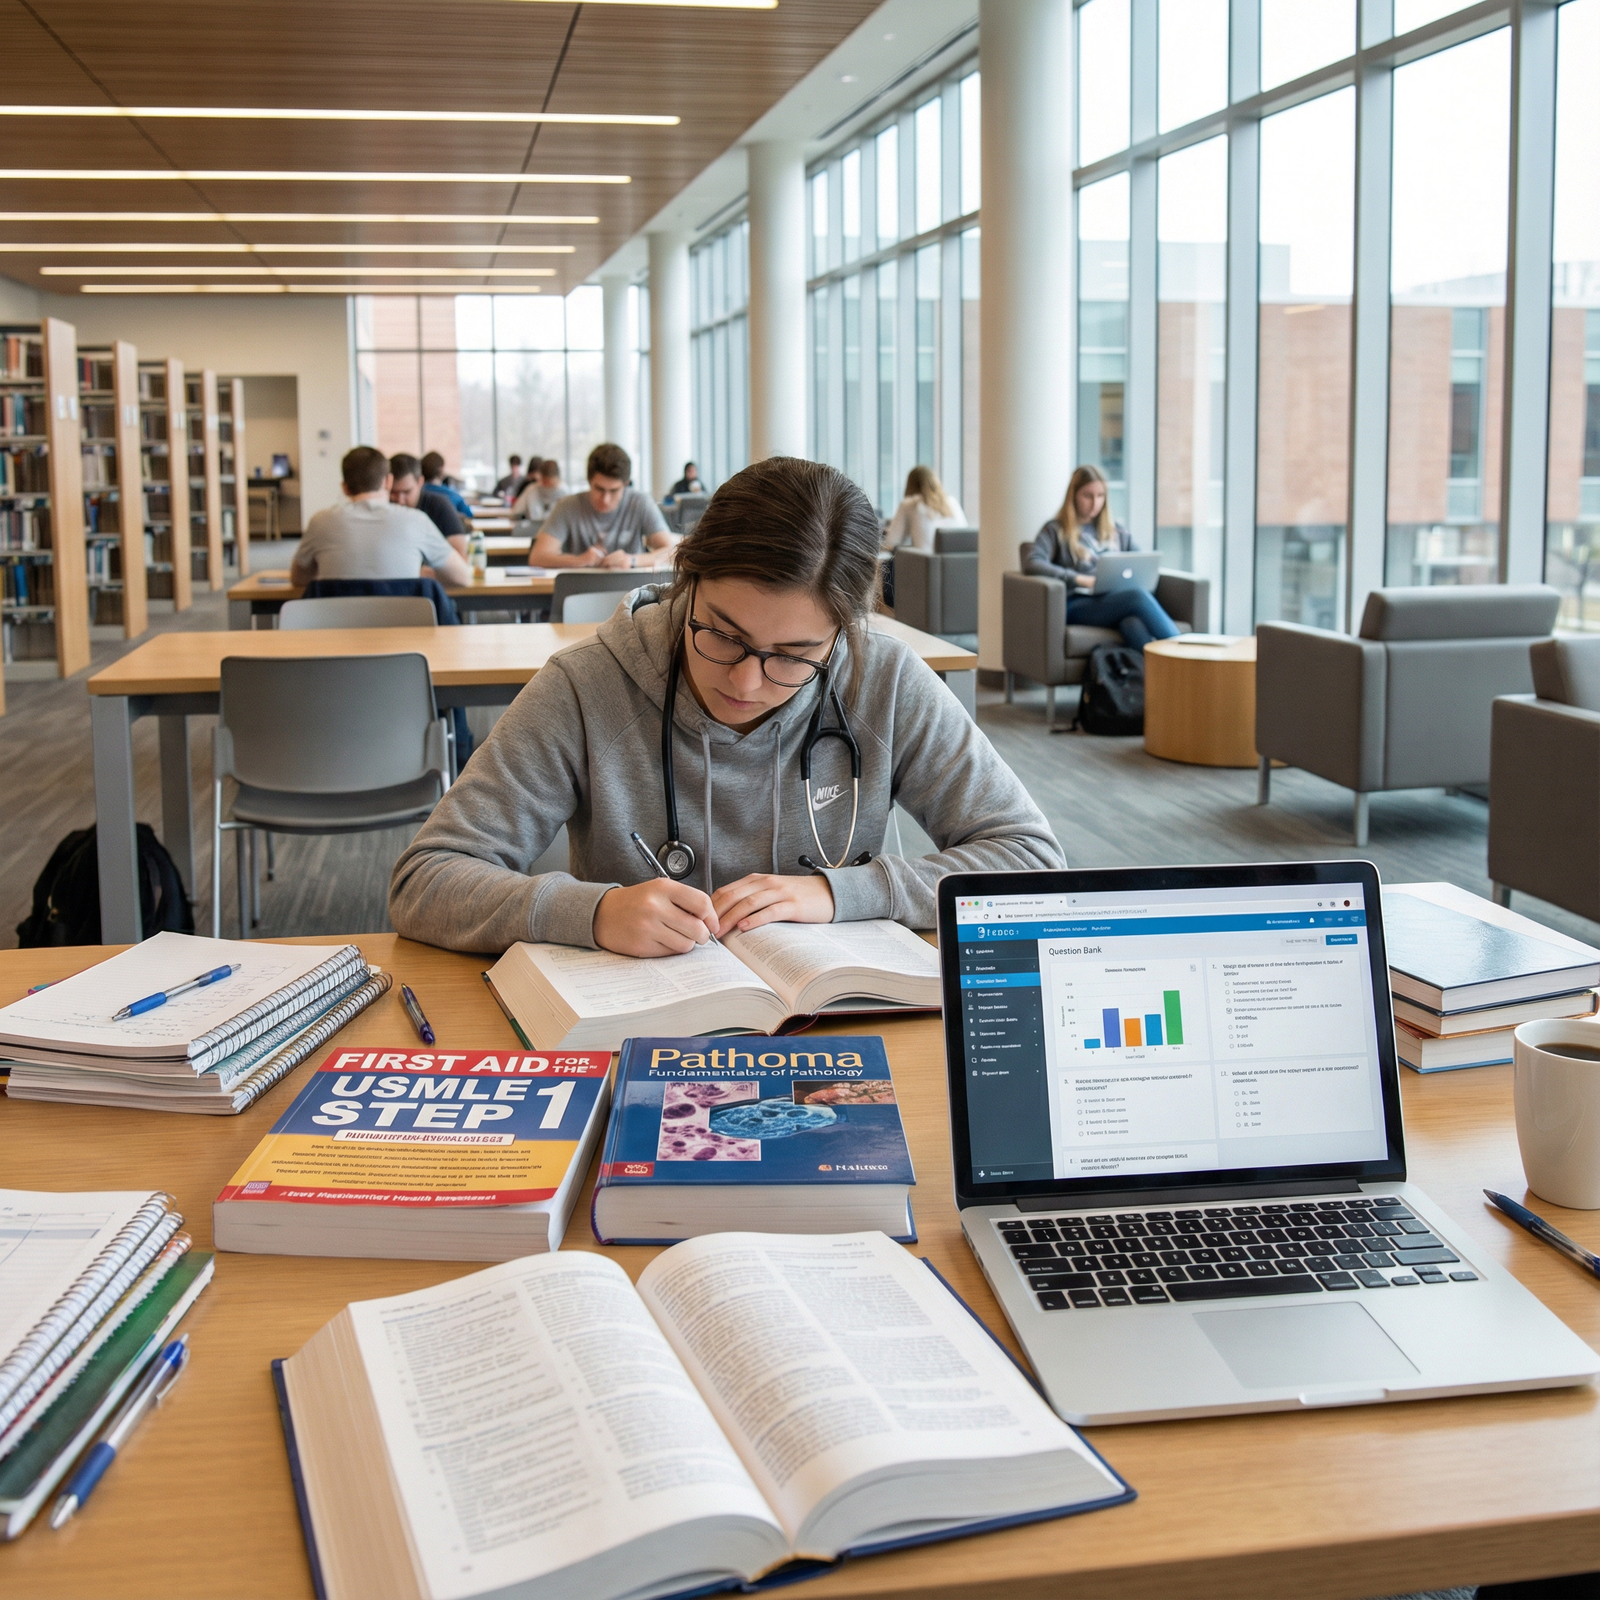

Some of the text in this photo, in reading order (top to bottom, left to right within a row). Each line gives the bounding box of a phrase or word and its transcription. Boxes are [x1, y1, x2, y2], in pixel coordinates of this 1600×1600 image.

[816, 784, 840, 800] NIKE
[1048, 946, 1102, 956] Question Bank
[333, 1053, 549, 1073] FIRST AID
[554, 1057, 590, 1065] FOR
[650, 1048, 864, 1068] Pathoma
[552, 1065, 589, 1074] THE
[789, 1068, 863, 1077] Pathology
[331, 1075, 533, 1101] USMLE
[311, 1081, 577, 1130] STEP 1
